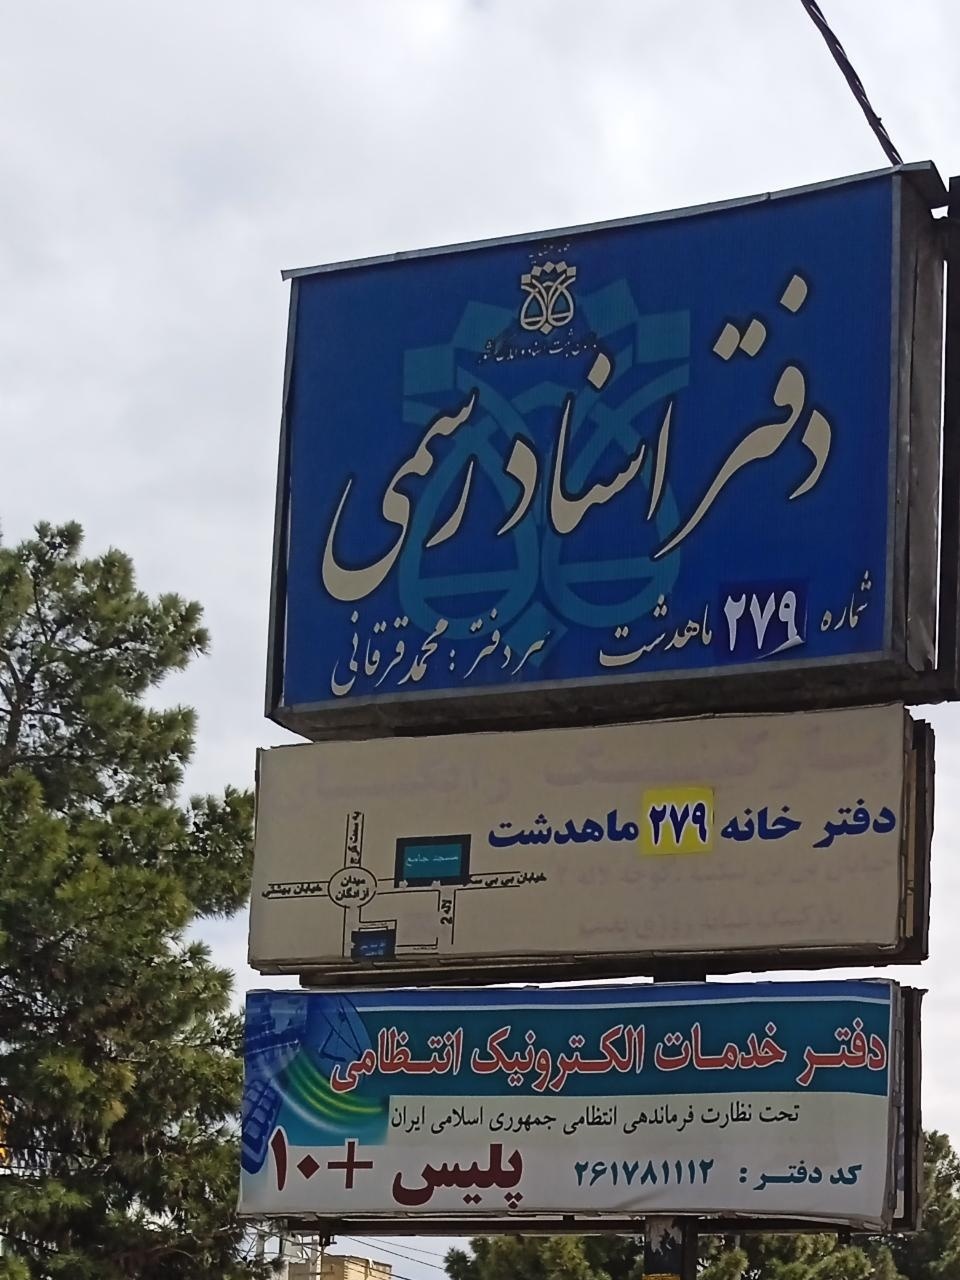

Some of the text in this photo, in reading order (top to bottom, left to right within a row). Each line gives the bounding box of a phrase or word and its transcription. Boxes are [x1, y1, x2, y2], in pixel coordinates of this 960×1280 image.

[321, 275, 832, 602] دفتر اسناد رسمی
[599, 570, 872, 667] شماره ۲۷۹ ماهدشت
[397, 618, 449, 686] محمد
[487, 797, 897, 848] دفتر خانه ۲۷۹ ماهدشت
[261, 882, 323, 898] خیابان بهشتی
[340, 875, 366, 886] میدان
[519, 870, 547, 884] خیابان
[330, 1017, 888, 1095] دفتر خدمات الکترونیک انتظامی
[391, 1101, 800, 1135] تحت نظارت فرماندهی انتظامی جمهوری اسلامی ایران
[388, 1142, 523, 1210] پلیس
[574, 1158, 714, 1187] ۲۶۱۷۸۱۱۱۲
[829, 1164, 864, 1186] کد
